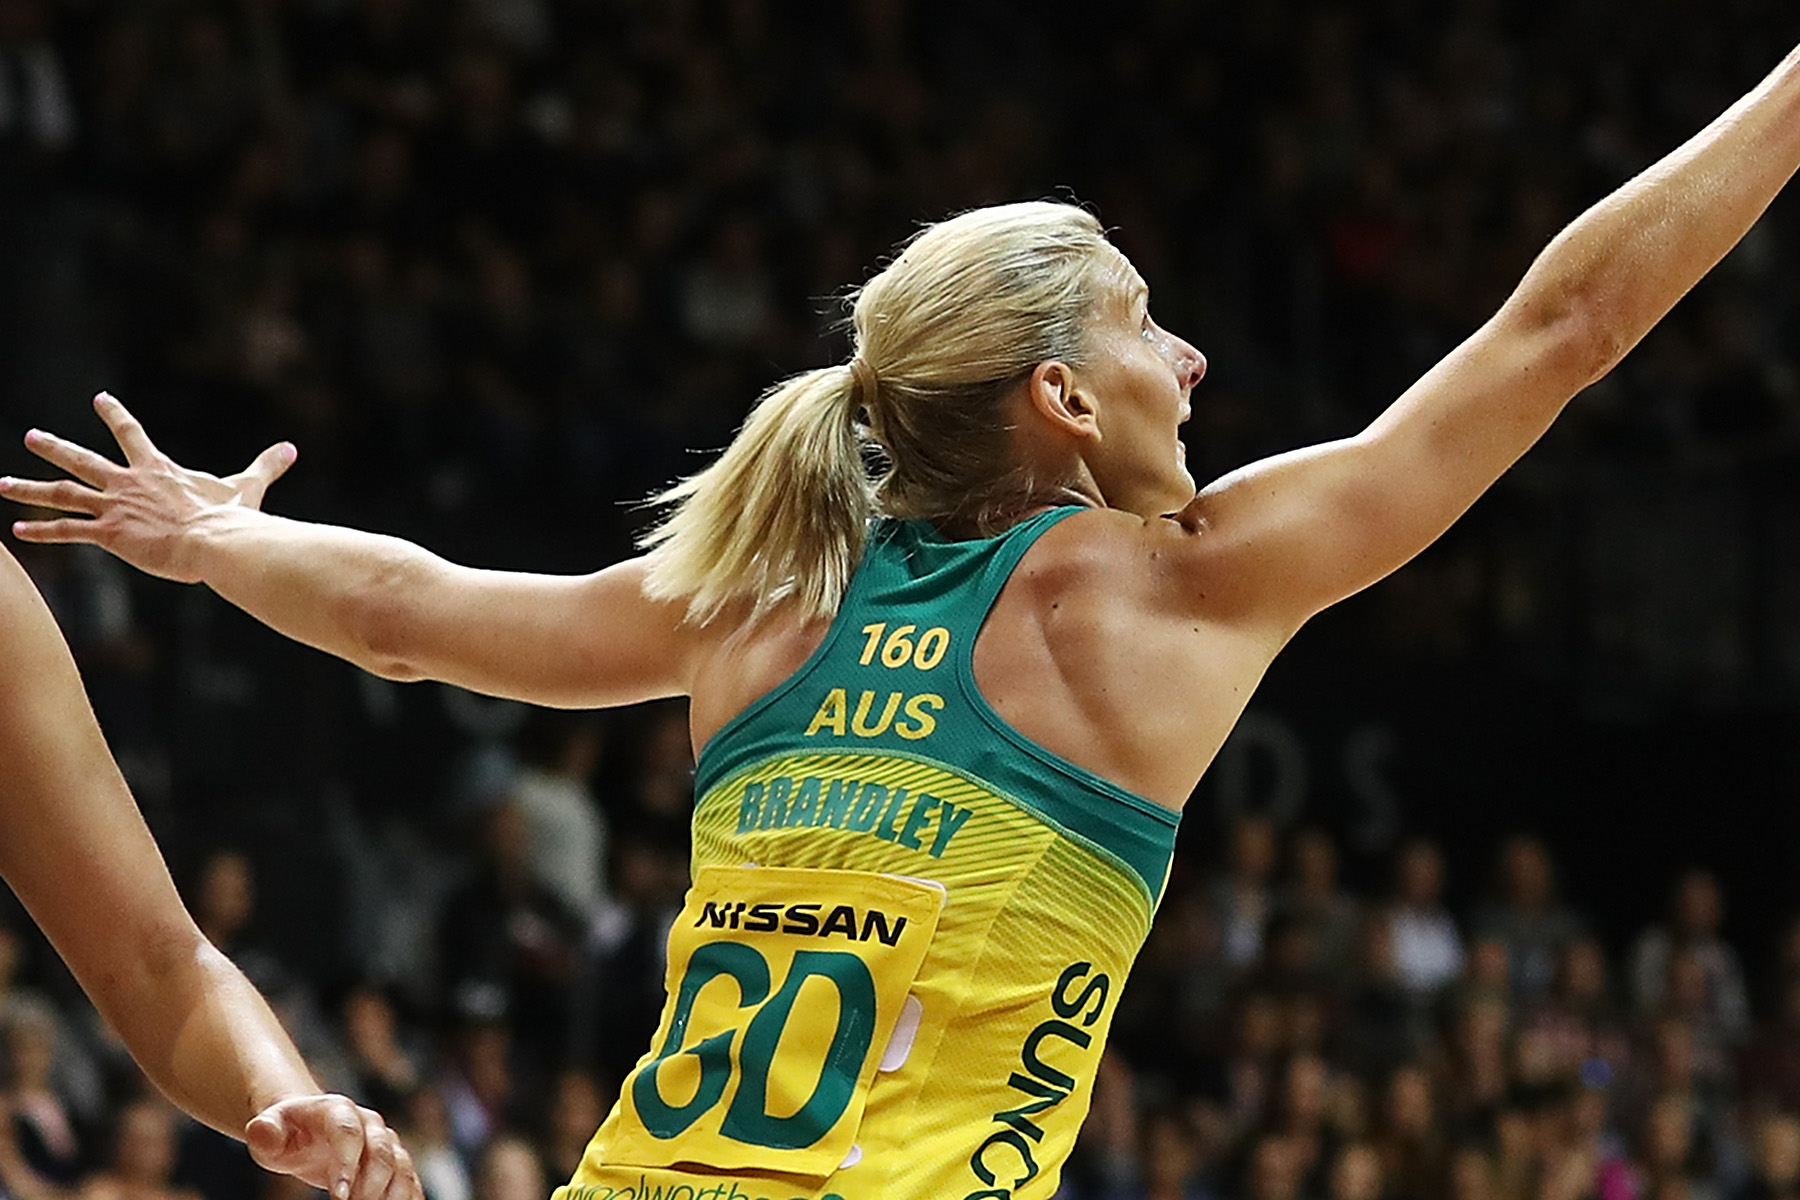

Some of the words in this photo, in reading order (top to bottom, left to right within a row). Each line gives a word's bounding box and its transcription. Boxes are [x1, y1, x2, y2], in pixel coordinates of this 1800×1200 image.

[859, 623, 950, 670] 160
[804, 689, 945, 740] AUS
[736, 776, 972, 859] BRANDLEY
[694, 901, 907, 947] NISSAN
[632, 941, 877, 1148] GD
[963, 961, 1110, 1200] SUNC
[565, 1174, 762, 1200] woolworth
